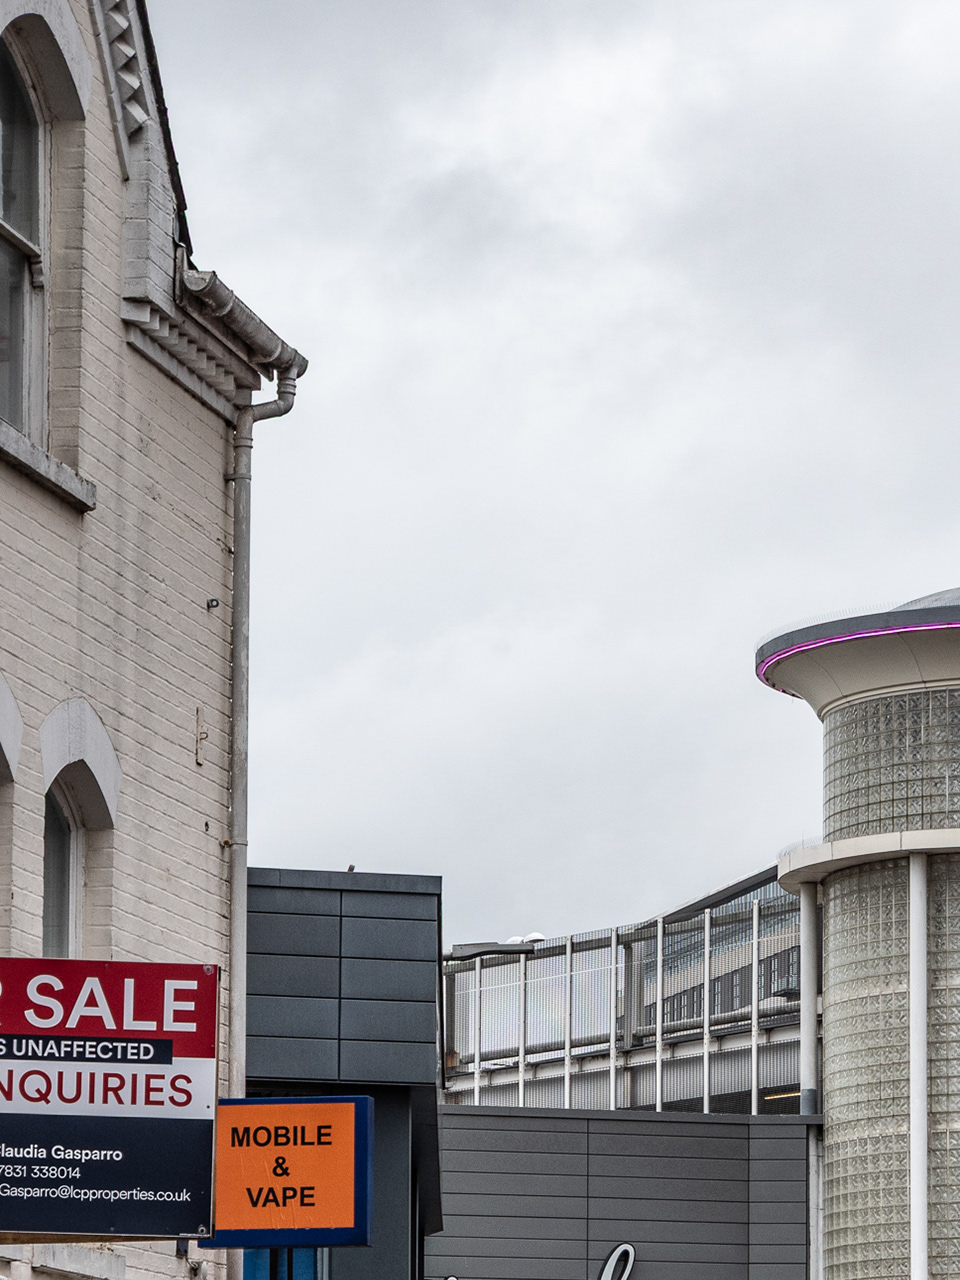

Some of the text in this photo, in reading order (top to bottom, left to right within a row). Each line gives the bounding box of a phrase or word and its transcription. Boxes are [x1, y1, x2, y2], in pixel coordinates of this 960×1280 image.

[24, 974, 198, 1032] SALE
[12, 1039, 154, 1060] UNAFFECTED
[230, 1125, 332, 1148] MOBILE
[0, 1143, 123, 1164] laudia Gasparro
[31, 1166, 81, 1179] 338014
[272, 1156, 290, 1178] &
[246, 1187, 316, 1208] VAPE
